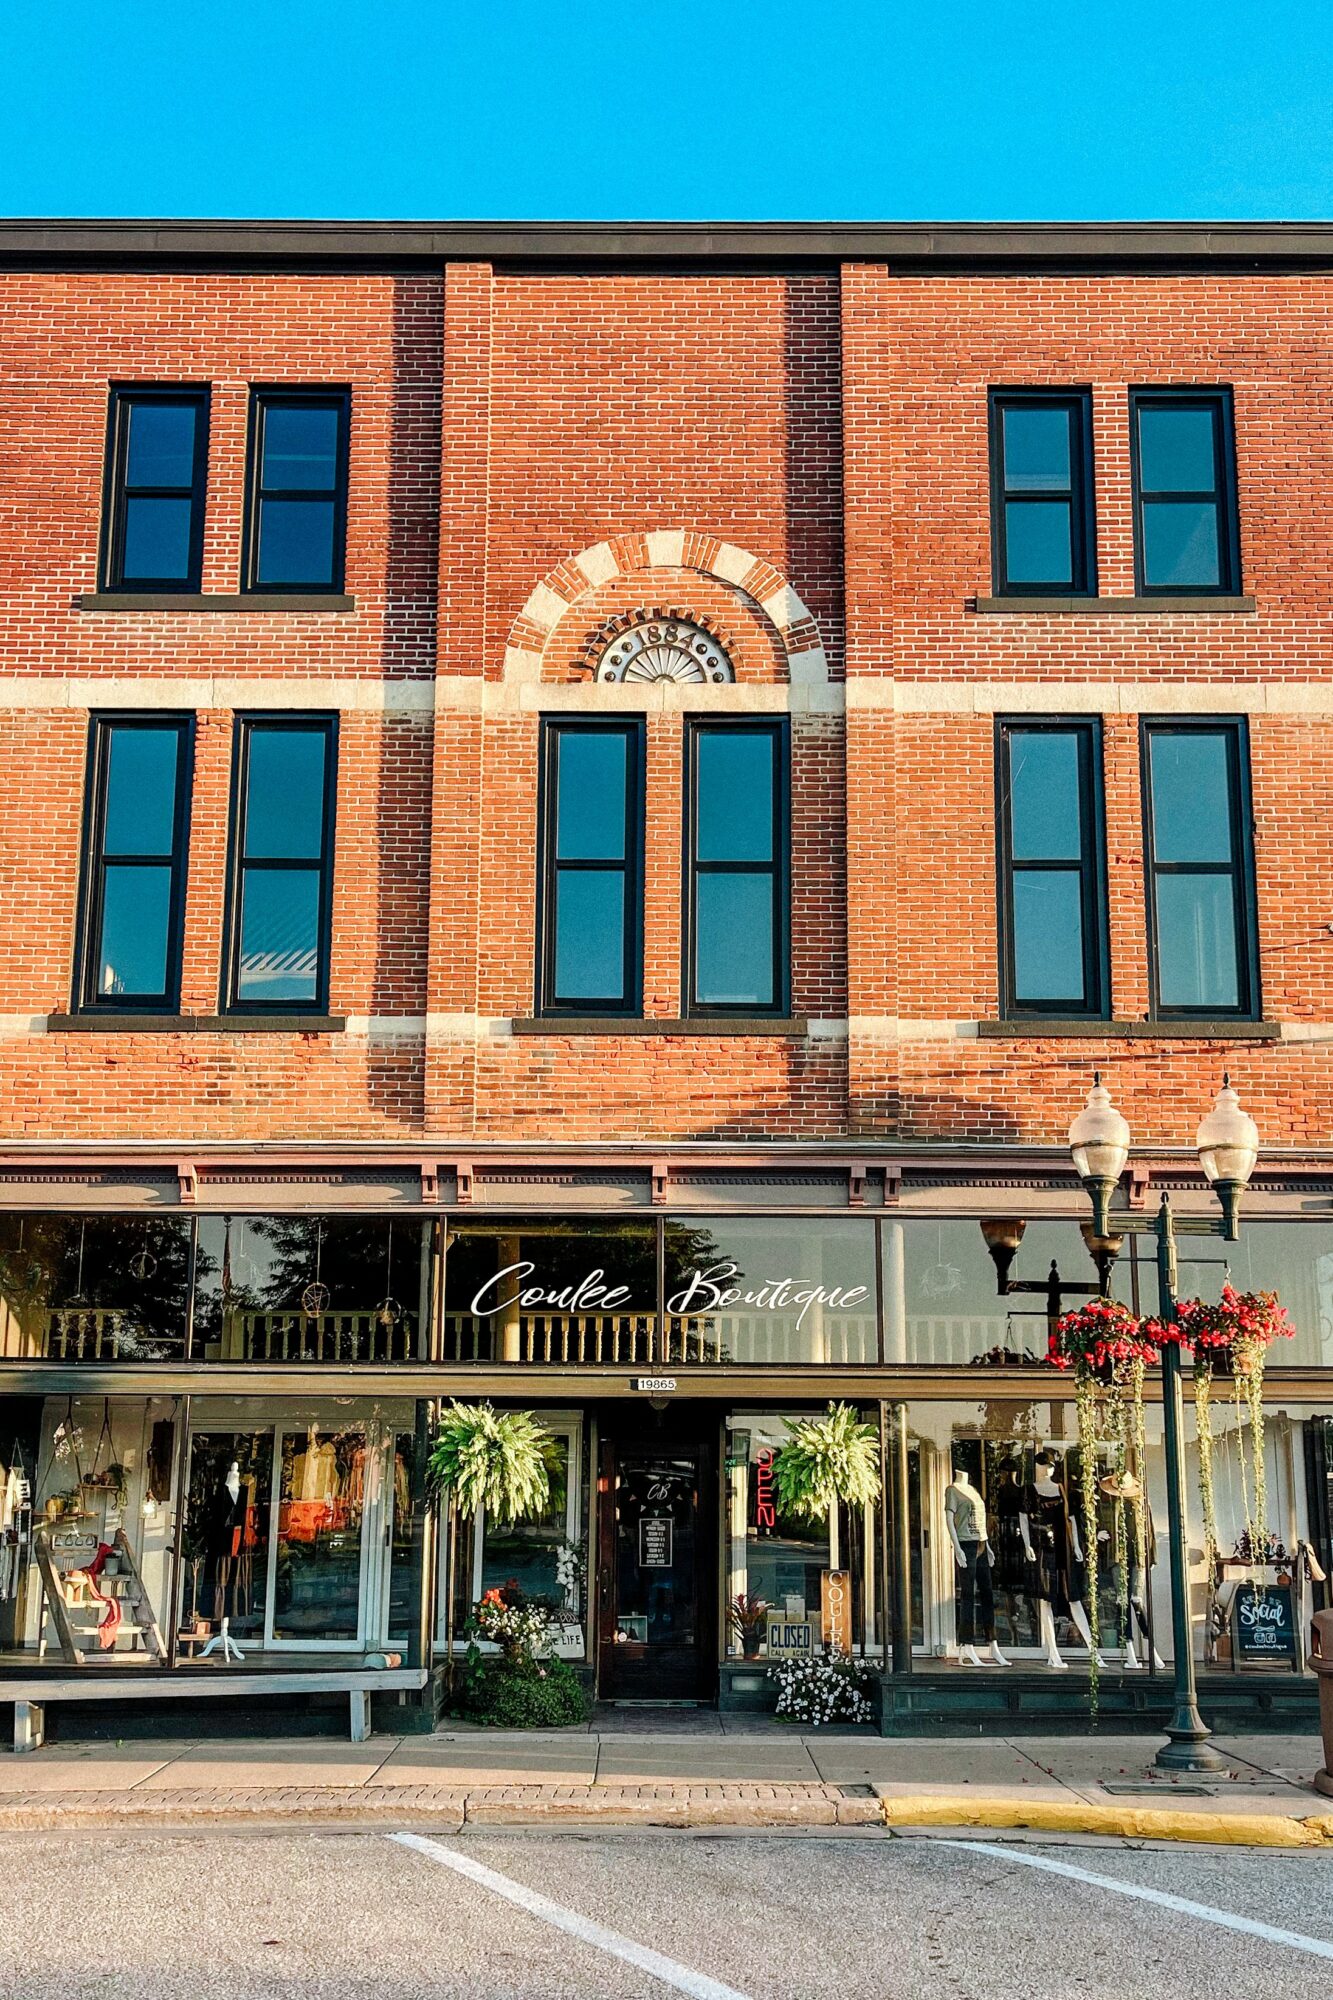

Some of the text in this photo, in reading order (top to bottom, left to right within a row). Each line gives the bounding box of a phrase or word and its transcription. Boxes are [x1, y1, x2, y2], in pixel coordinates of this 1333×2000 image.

[635, 625, 697, 649] 1884
[470, 1261, 870, 1331] Coulee Boutique
[640, 1380, 675, 1389] 19865
[757, 1448, 776, 1527] OPEN
[1240, 1603, 1285, 1627] Social
[561, 1635, 581, 1645] LIFE
[771, 1625, 810, 1649] CLOSED
[792, 1649, 810, 1657] AGAIN
